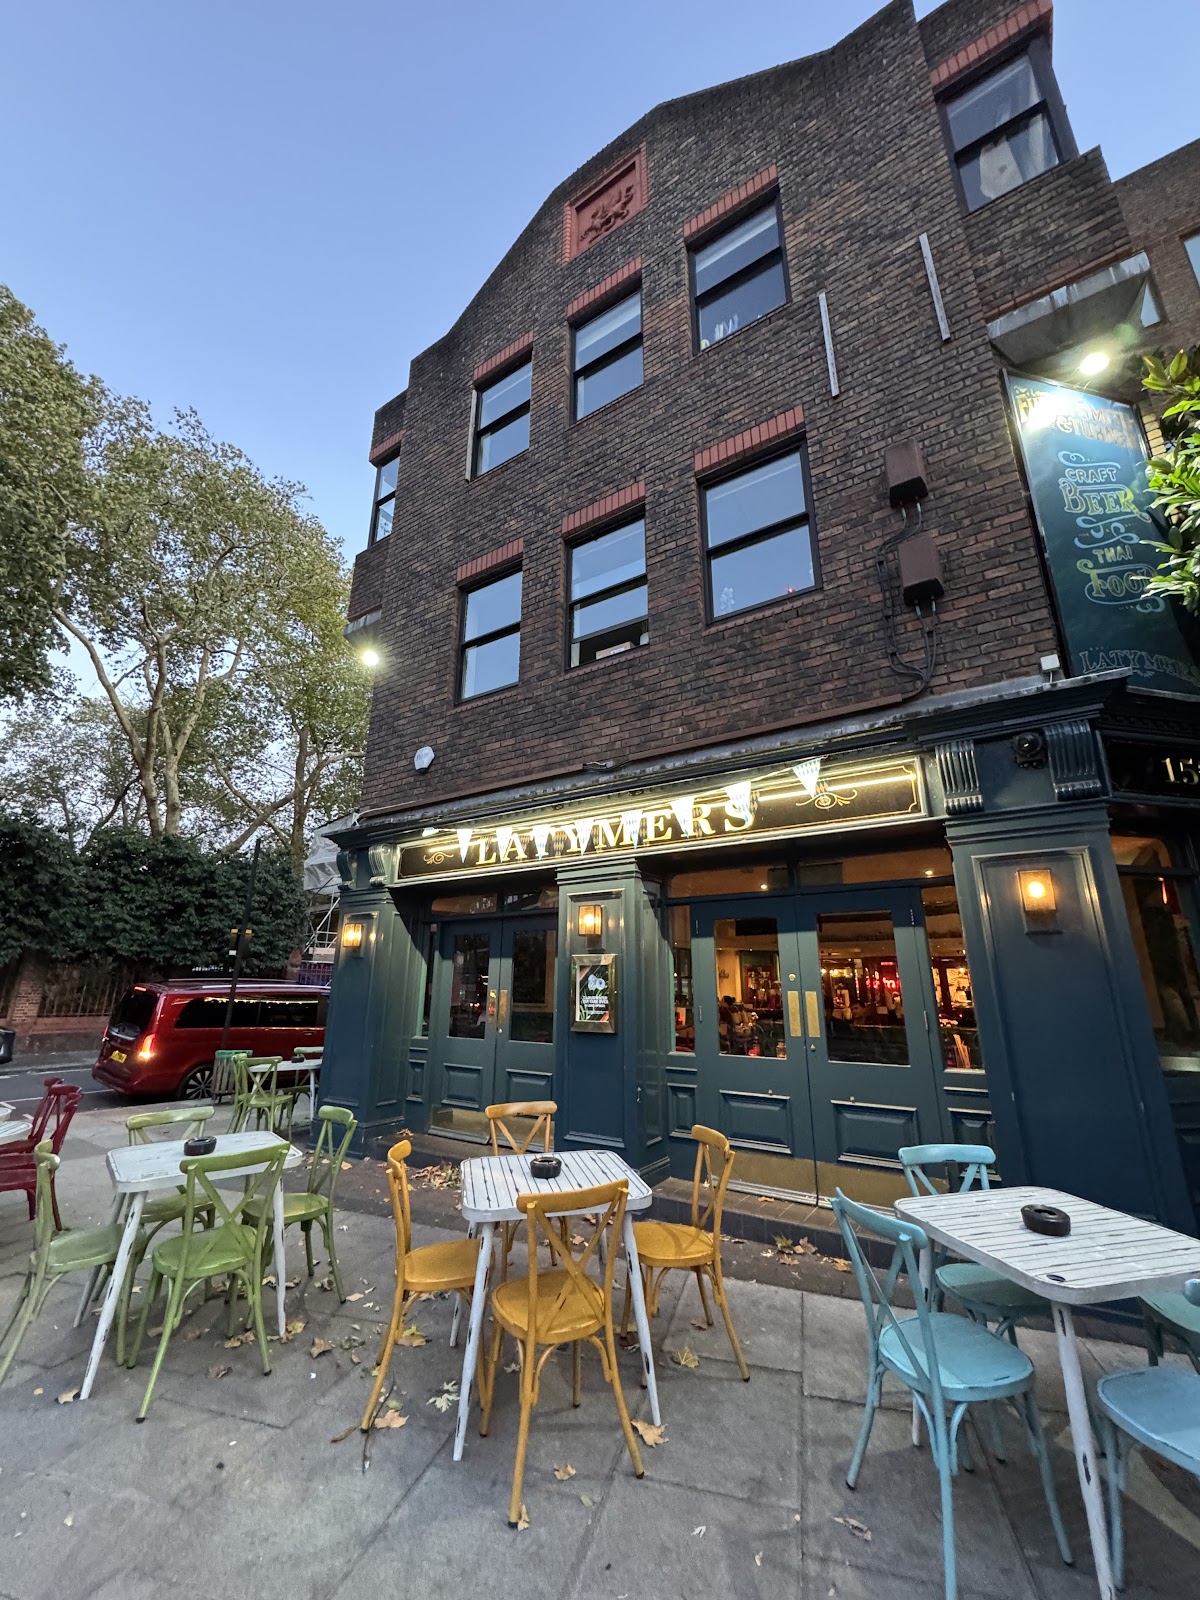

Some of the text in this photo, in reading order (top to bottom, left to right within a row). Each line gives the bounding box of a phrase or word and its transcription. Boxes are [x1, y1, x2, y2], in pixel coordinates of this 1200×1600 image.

[1065, 467, 1116, 483] CRAFT
[1058, 478, 1151, 523] BEER
[1092, 545, 1134, 564] THAI
[475, 797, 754, 866] LATYMERS
